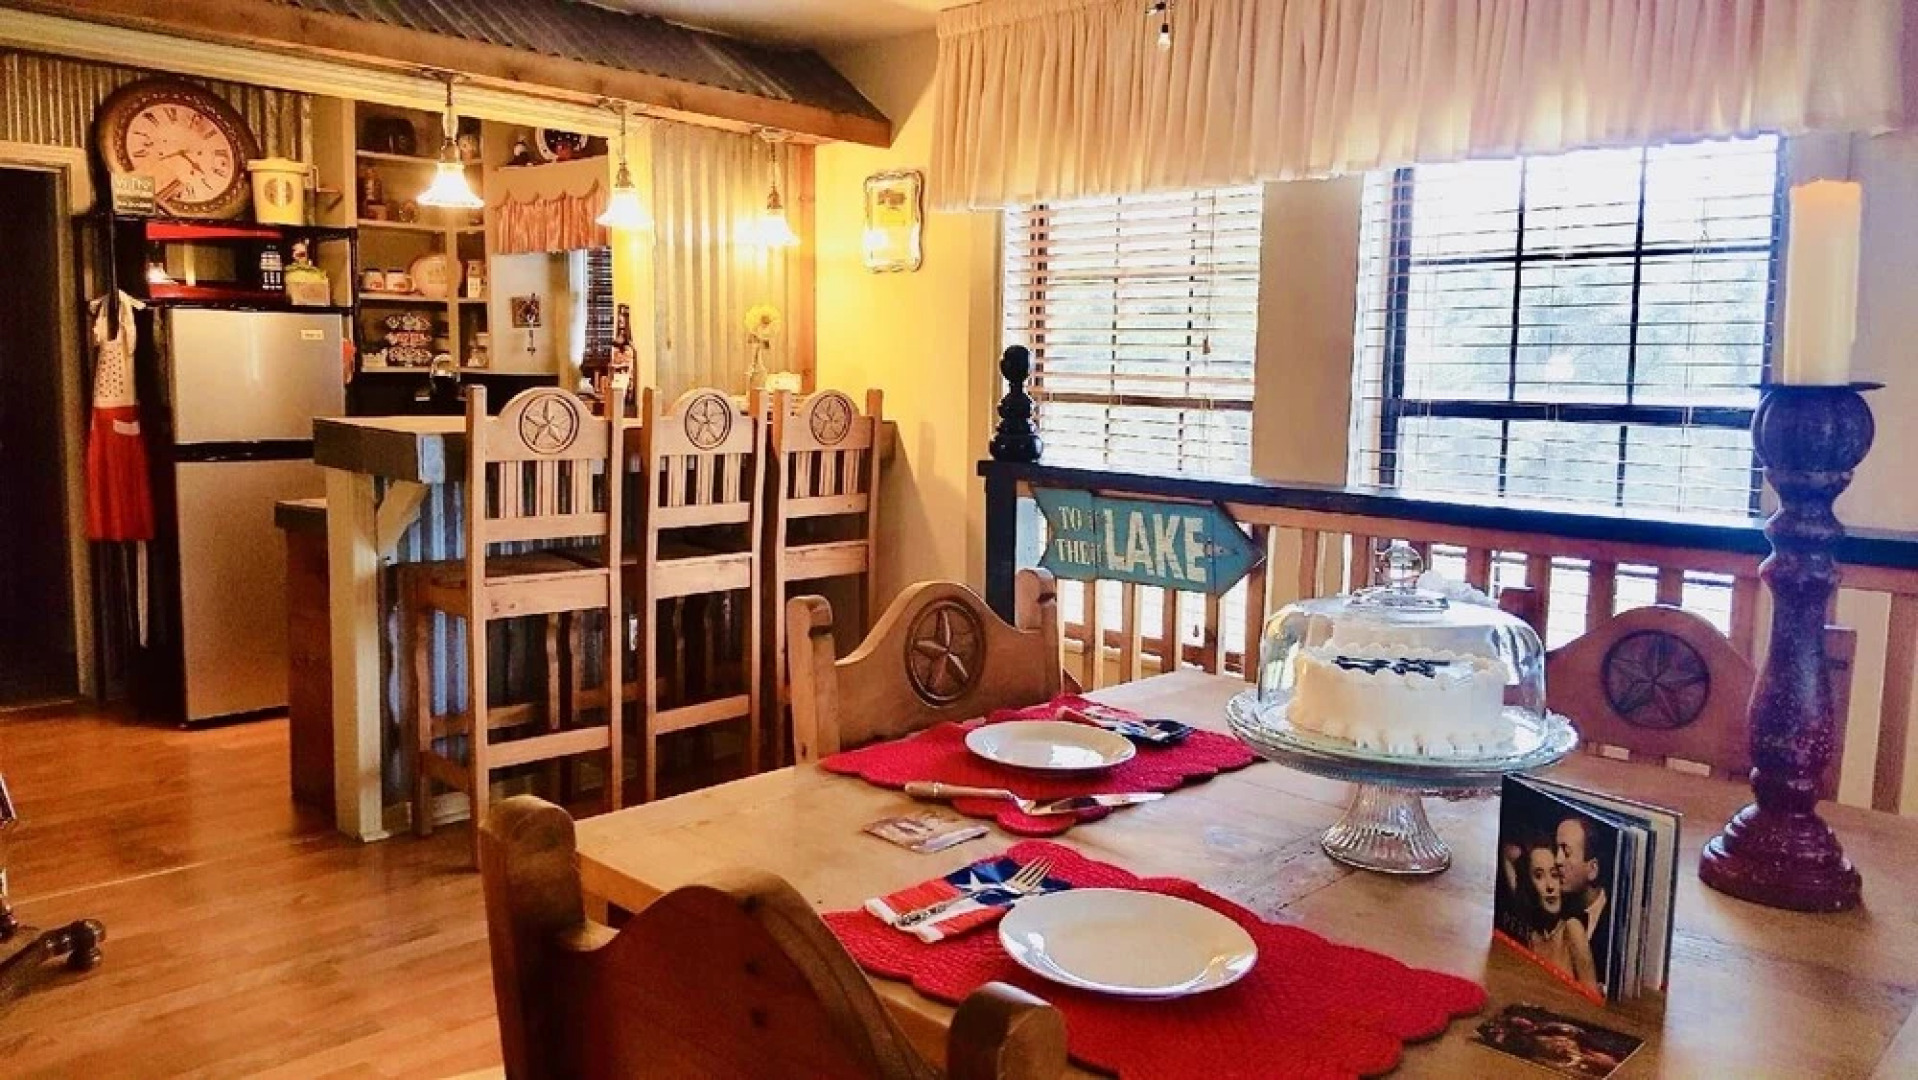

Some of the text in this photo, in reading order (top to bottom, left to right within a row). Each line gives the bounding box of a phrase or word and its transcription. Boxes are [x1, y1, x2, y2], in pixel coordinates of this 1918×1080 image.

[1058, 505, 1082, 531] TO
[1055, 538, 1091, 565] THE
[1104, 507, 1207, 584] LAKE
